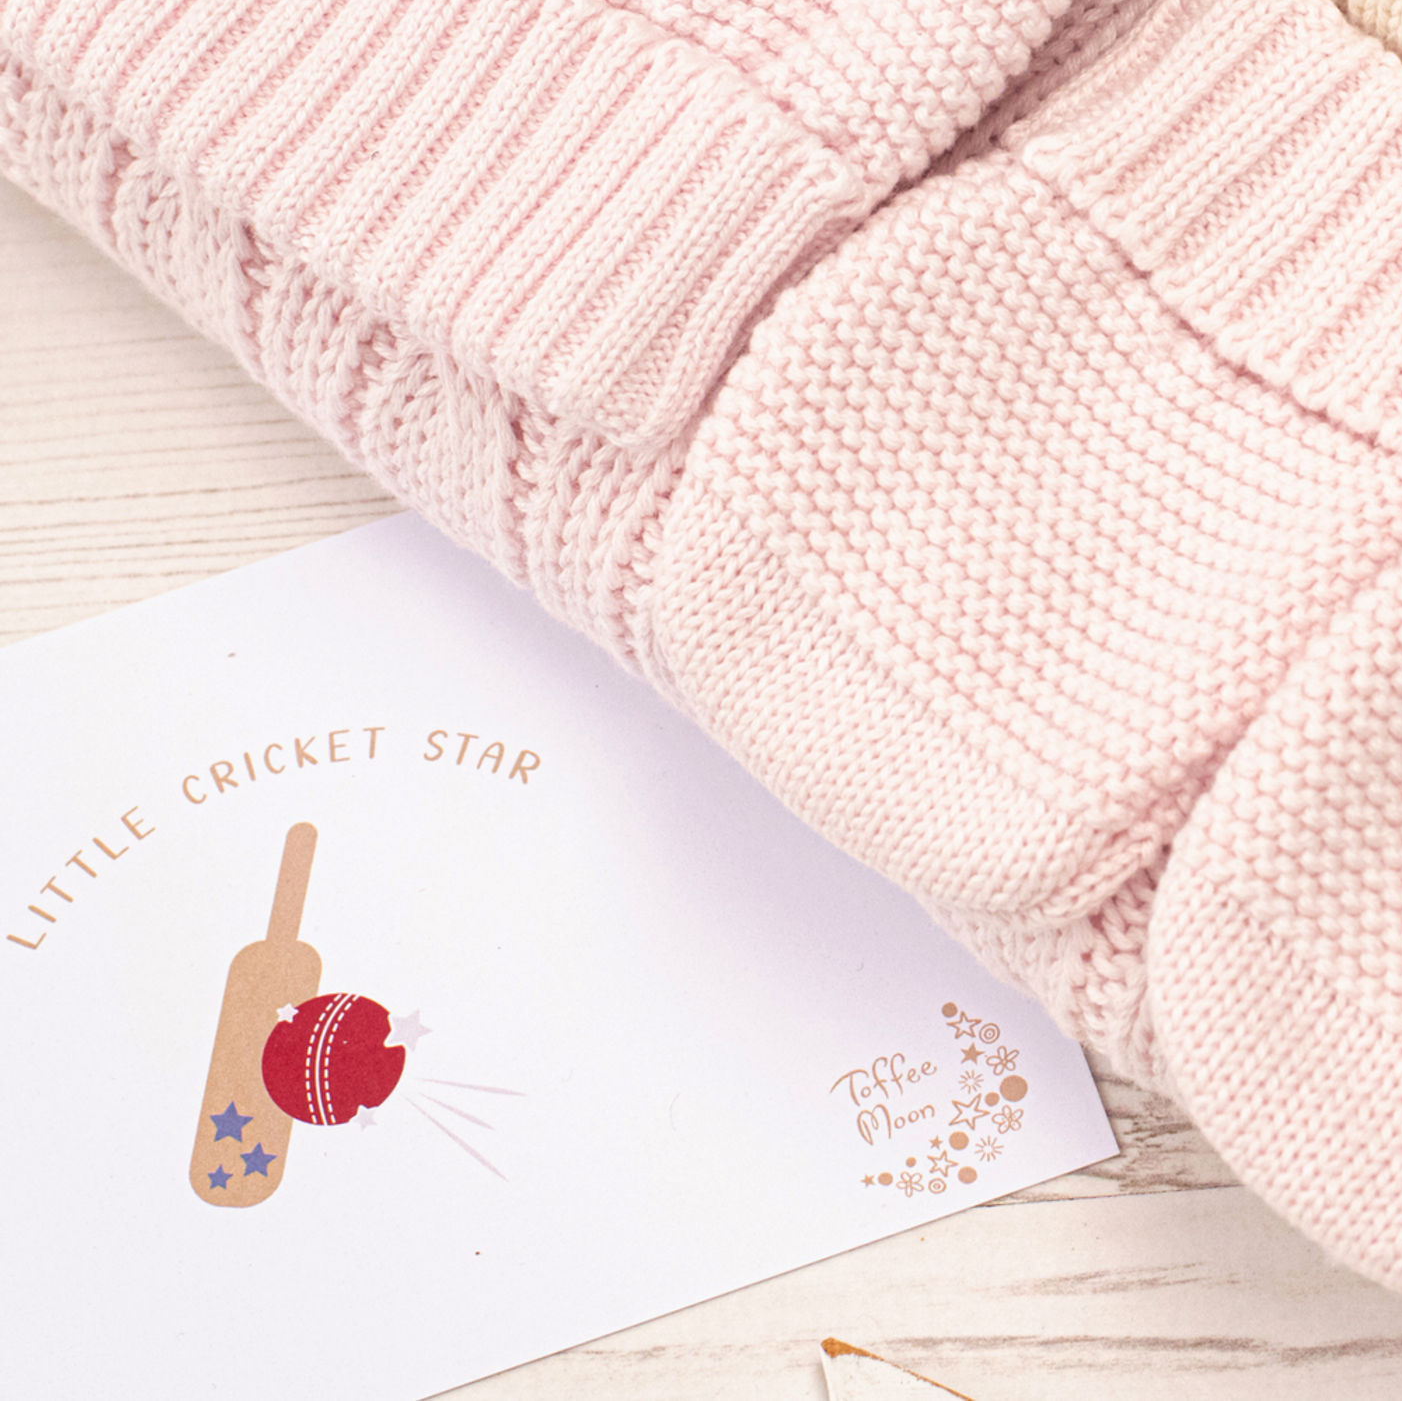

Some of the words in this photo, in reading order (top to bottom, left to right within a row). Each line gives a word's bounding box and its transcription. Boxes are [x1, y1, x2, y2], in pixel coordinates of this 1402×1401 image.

[6, 806, 156, 949] LITTLE
[182, 727, 385, 804] CRICKET
[423, 730, 541, 784] STAR
[829, 1053, 937, 1106] Toffee
[856, 1104, 935, 1146] Moon
